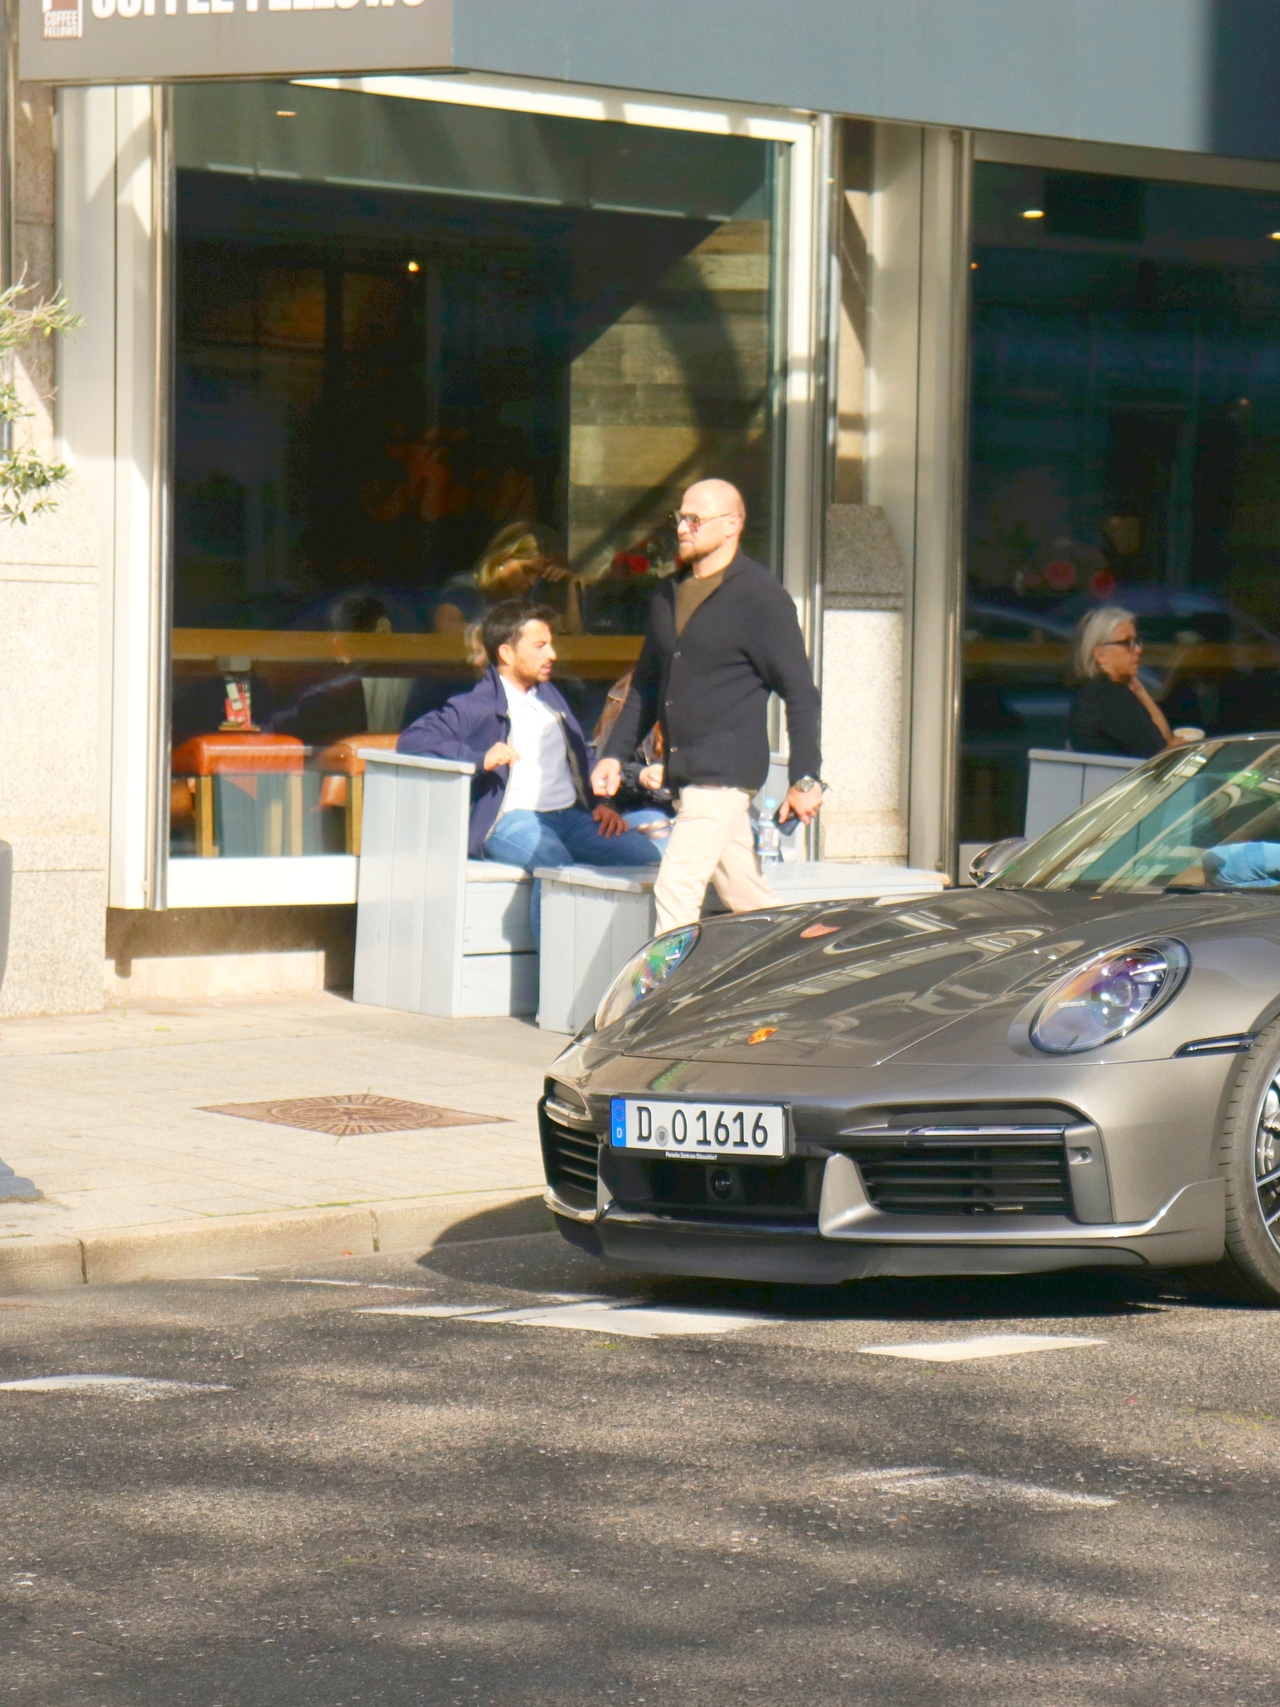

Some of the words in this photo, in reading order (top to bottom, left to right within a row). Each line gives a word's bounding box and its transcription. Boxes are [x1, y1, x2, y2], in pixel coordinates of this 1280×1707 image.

[44, 11, 78, 26] COFFEE
[616, 1127, 623, 1139] D
[637, 1106, 652, 1142] D
[696, 1110, 768, 1147] 1616
